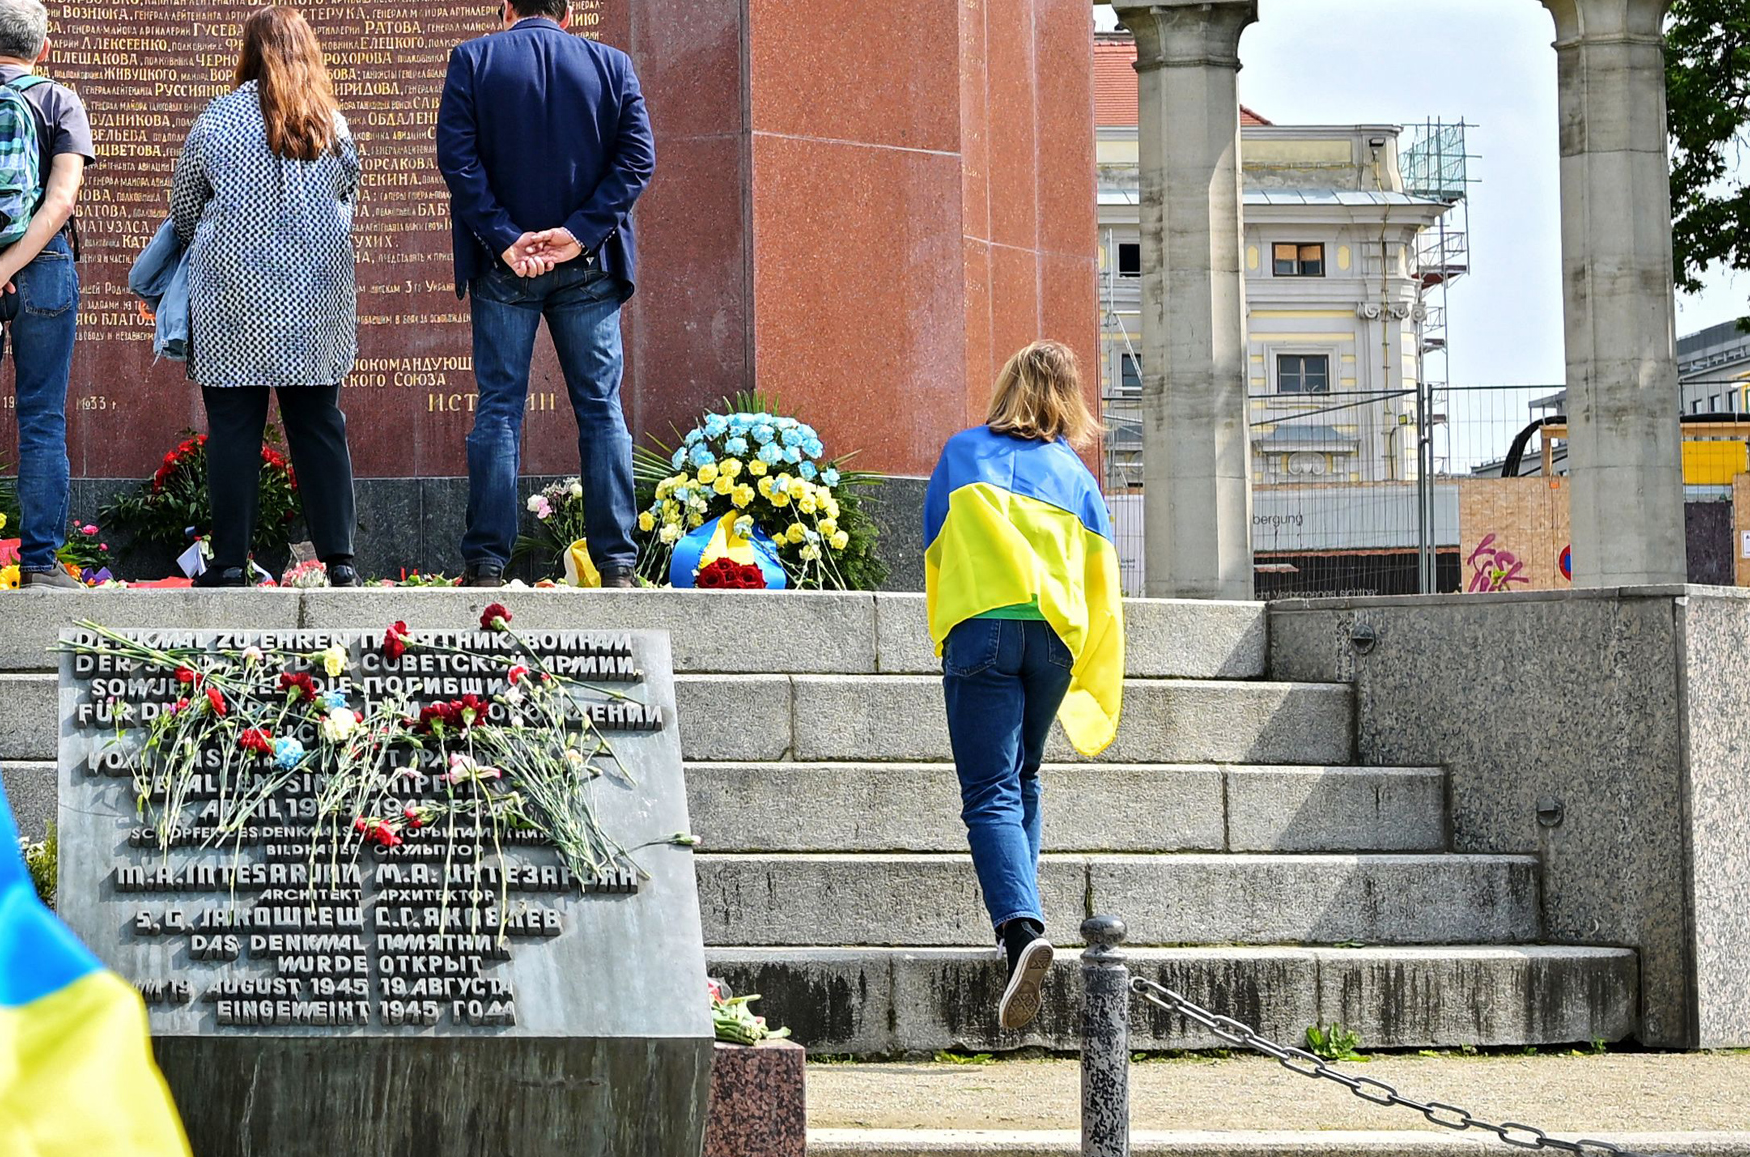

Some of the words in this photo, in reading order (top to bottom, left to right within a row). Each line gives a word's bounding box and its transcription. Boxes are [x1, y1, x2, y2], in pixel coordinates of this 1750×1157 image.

[217, 632, 252, 650] ZU
[259, 632, 350, 650] EHREN
[523, 632, 631, 651] ВОИНАМ
[76, 655, 131, 673] DER
[260, 889, 362, 901] ARCHITEKT
[377, 889, 495, 902] АРХИТЕКТОР
[191, 935, 238, 952] DAS
[250, 934, 365, 952] DENKMAL
[278, 955, 368, 973] WURDE
[379, 955, 483, 973] ОТКРЫТ
[208, 978, 300, 996] AUGUST
[310, 977, 369, 996] 1945
[409, 977, 513, 996] АВГУСТА
[217, 1000, 370, 1018] EINGEWEIHT
[379, 999, 439, 1018] 1945
[452, 999, 515, 1018] ГОДА
